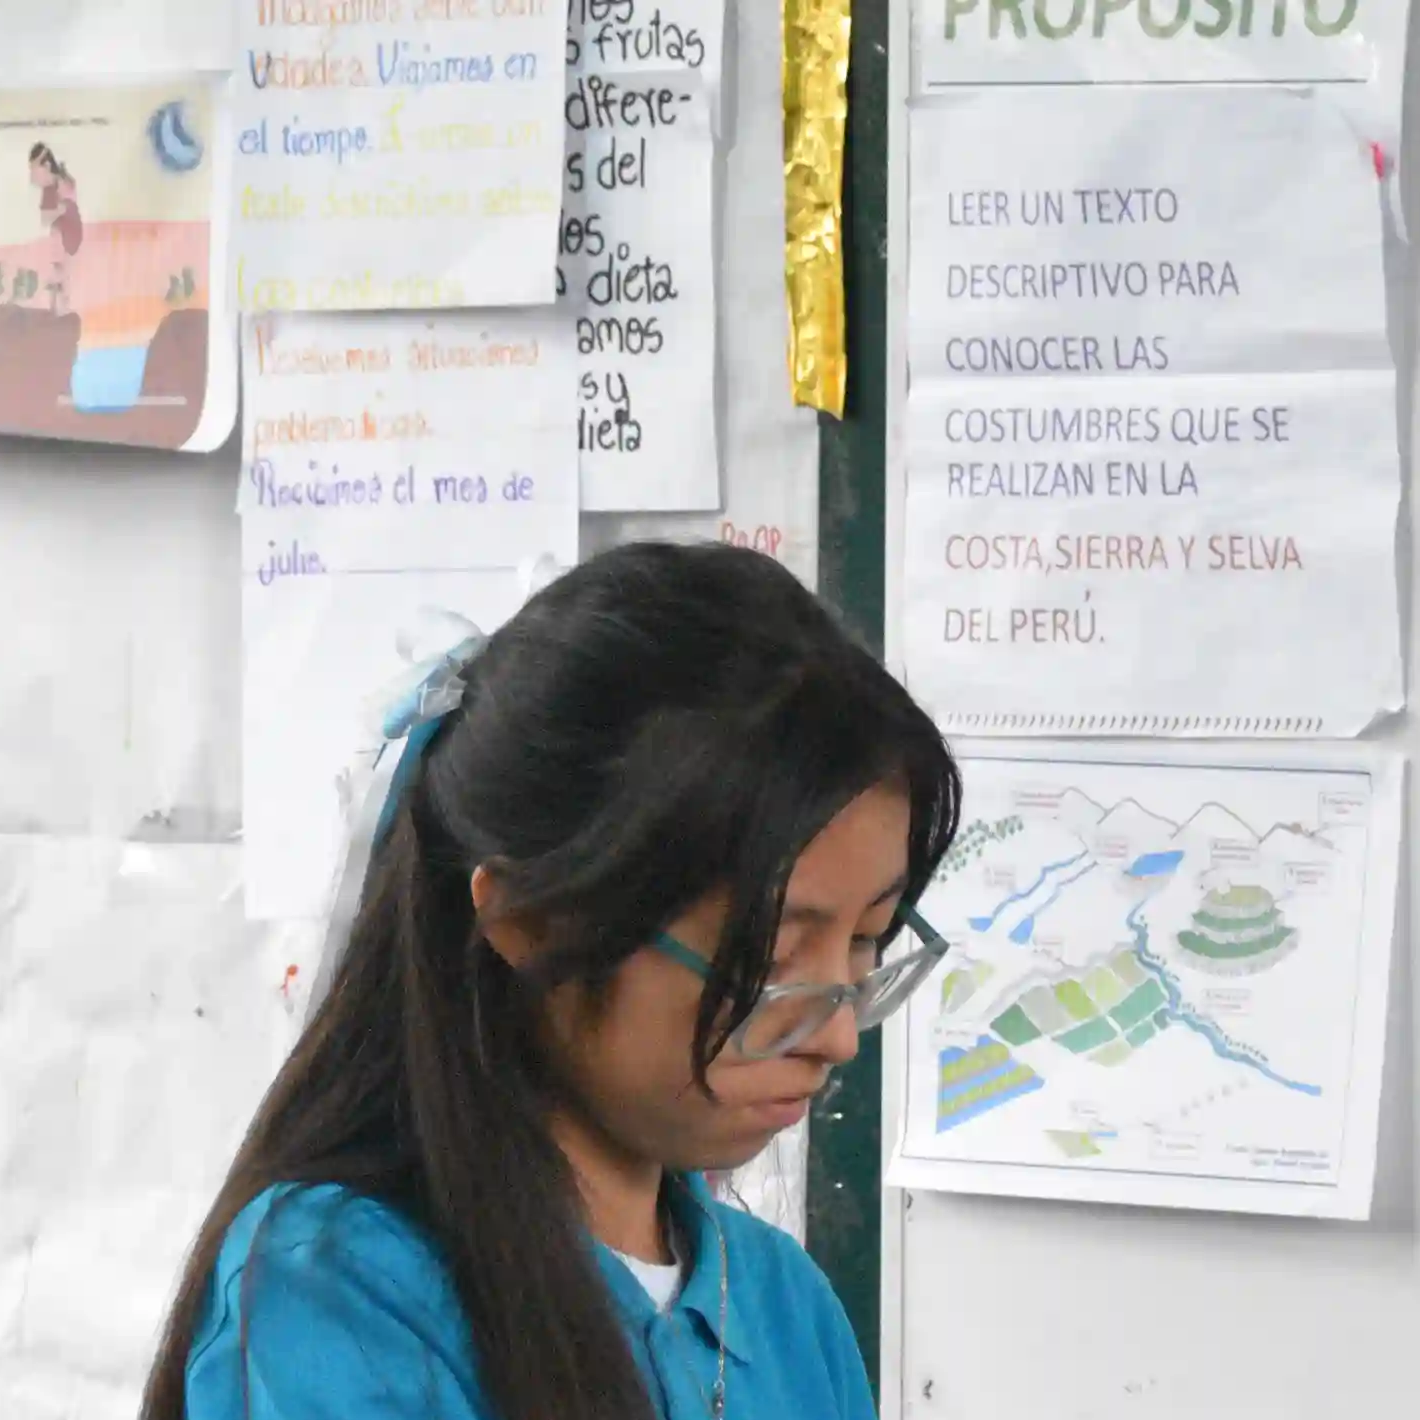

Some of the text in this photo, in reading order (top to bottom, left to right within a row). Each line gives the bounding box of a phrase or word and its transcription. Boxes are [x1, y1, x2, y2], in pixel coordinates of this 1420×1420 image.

[592, 9, 705, 67] frutas
[597, 137, 645, 190] del
[948, 188, 1179, 227] LEER UN TEXTO
[587, 243, 679, 304] dieta
[947, 260, 1240, 300] DESCRIPTIVO PARA
[946, 336, 1170, 372] CONOCER LAS
[945, 406, 1290, 446] COSTUMBRES QUE SE
[502, 472, 535, 502] de
[947, 461, 1198, 498] REALIZAN EN LA
[1178, 536, 1196, 570] Y
[1208, 535, 1303, 571] SELVA
[943, 590, 1106, 645] DEL PERÚ.
